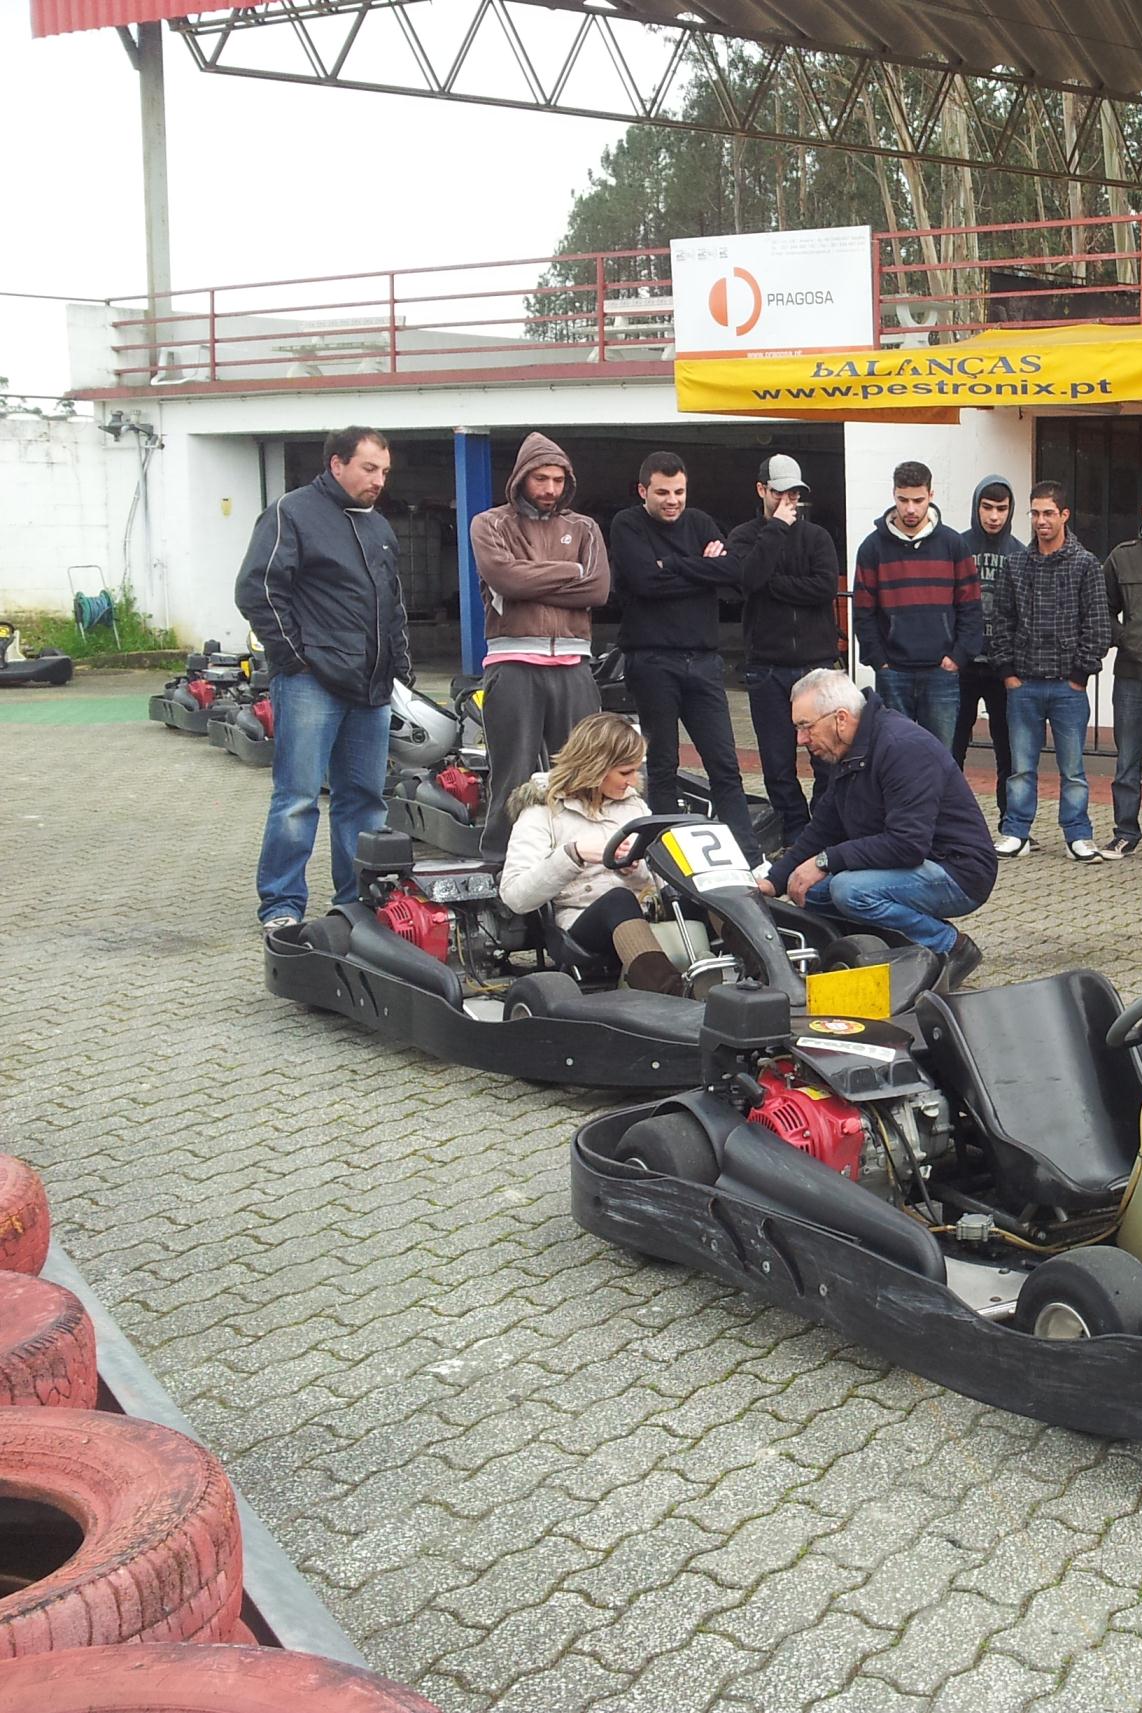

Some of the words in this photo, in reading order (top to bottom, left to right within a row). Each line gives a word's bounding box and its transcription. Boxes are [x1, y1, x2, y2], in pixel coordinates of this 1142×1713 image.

[767, 290, 834, 307] PRAGOSA
[752, 379, 1113, 400] www.pestronix.pt
[690, 830, 733, 867] 2
